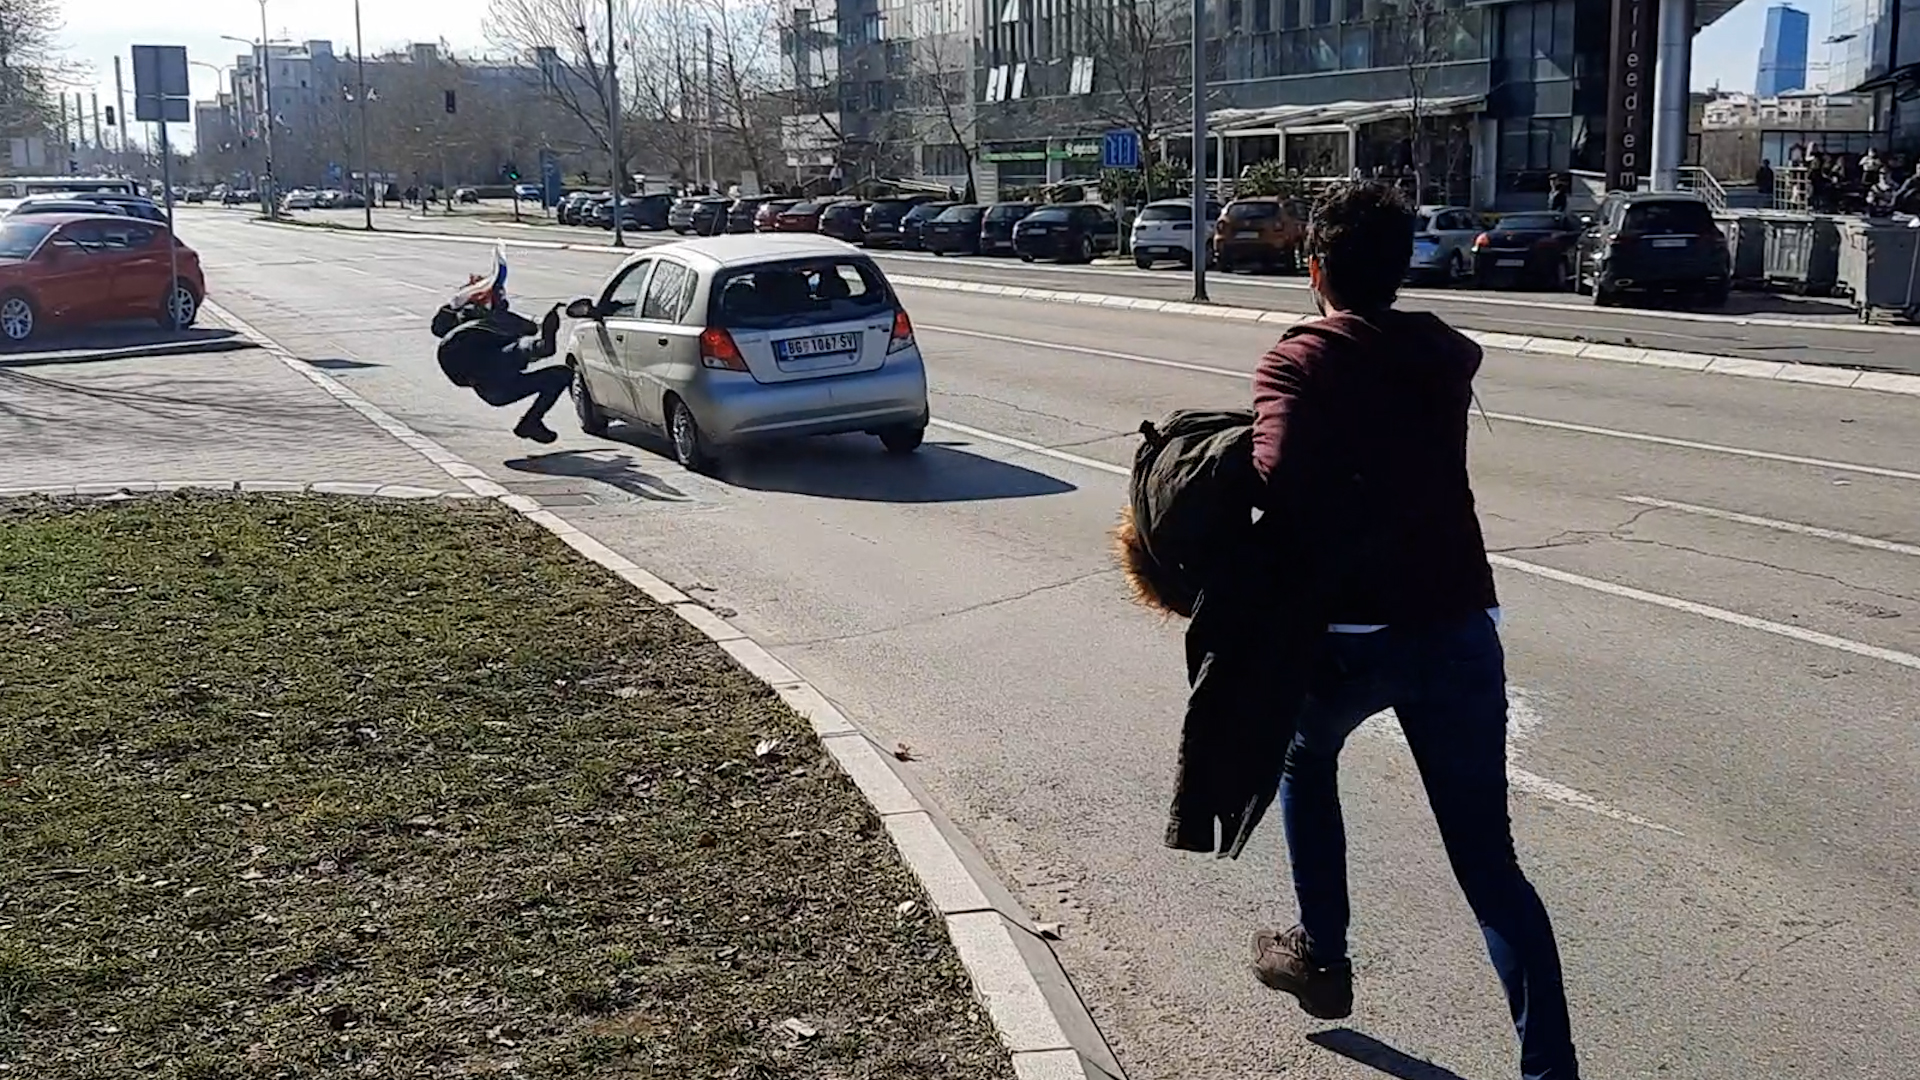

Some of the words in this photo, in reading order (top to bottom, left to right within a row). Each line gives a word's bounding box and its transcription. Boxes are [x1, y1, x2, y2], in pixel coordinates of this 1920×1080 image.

[1620, 0, 1639, 187] ffeedream
[788, 340, 803, 354] BG
[811, 337, 836, 351] 1067
[840, 334, 853, 348] SV
